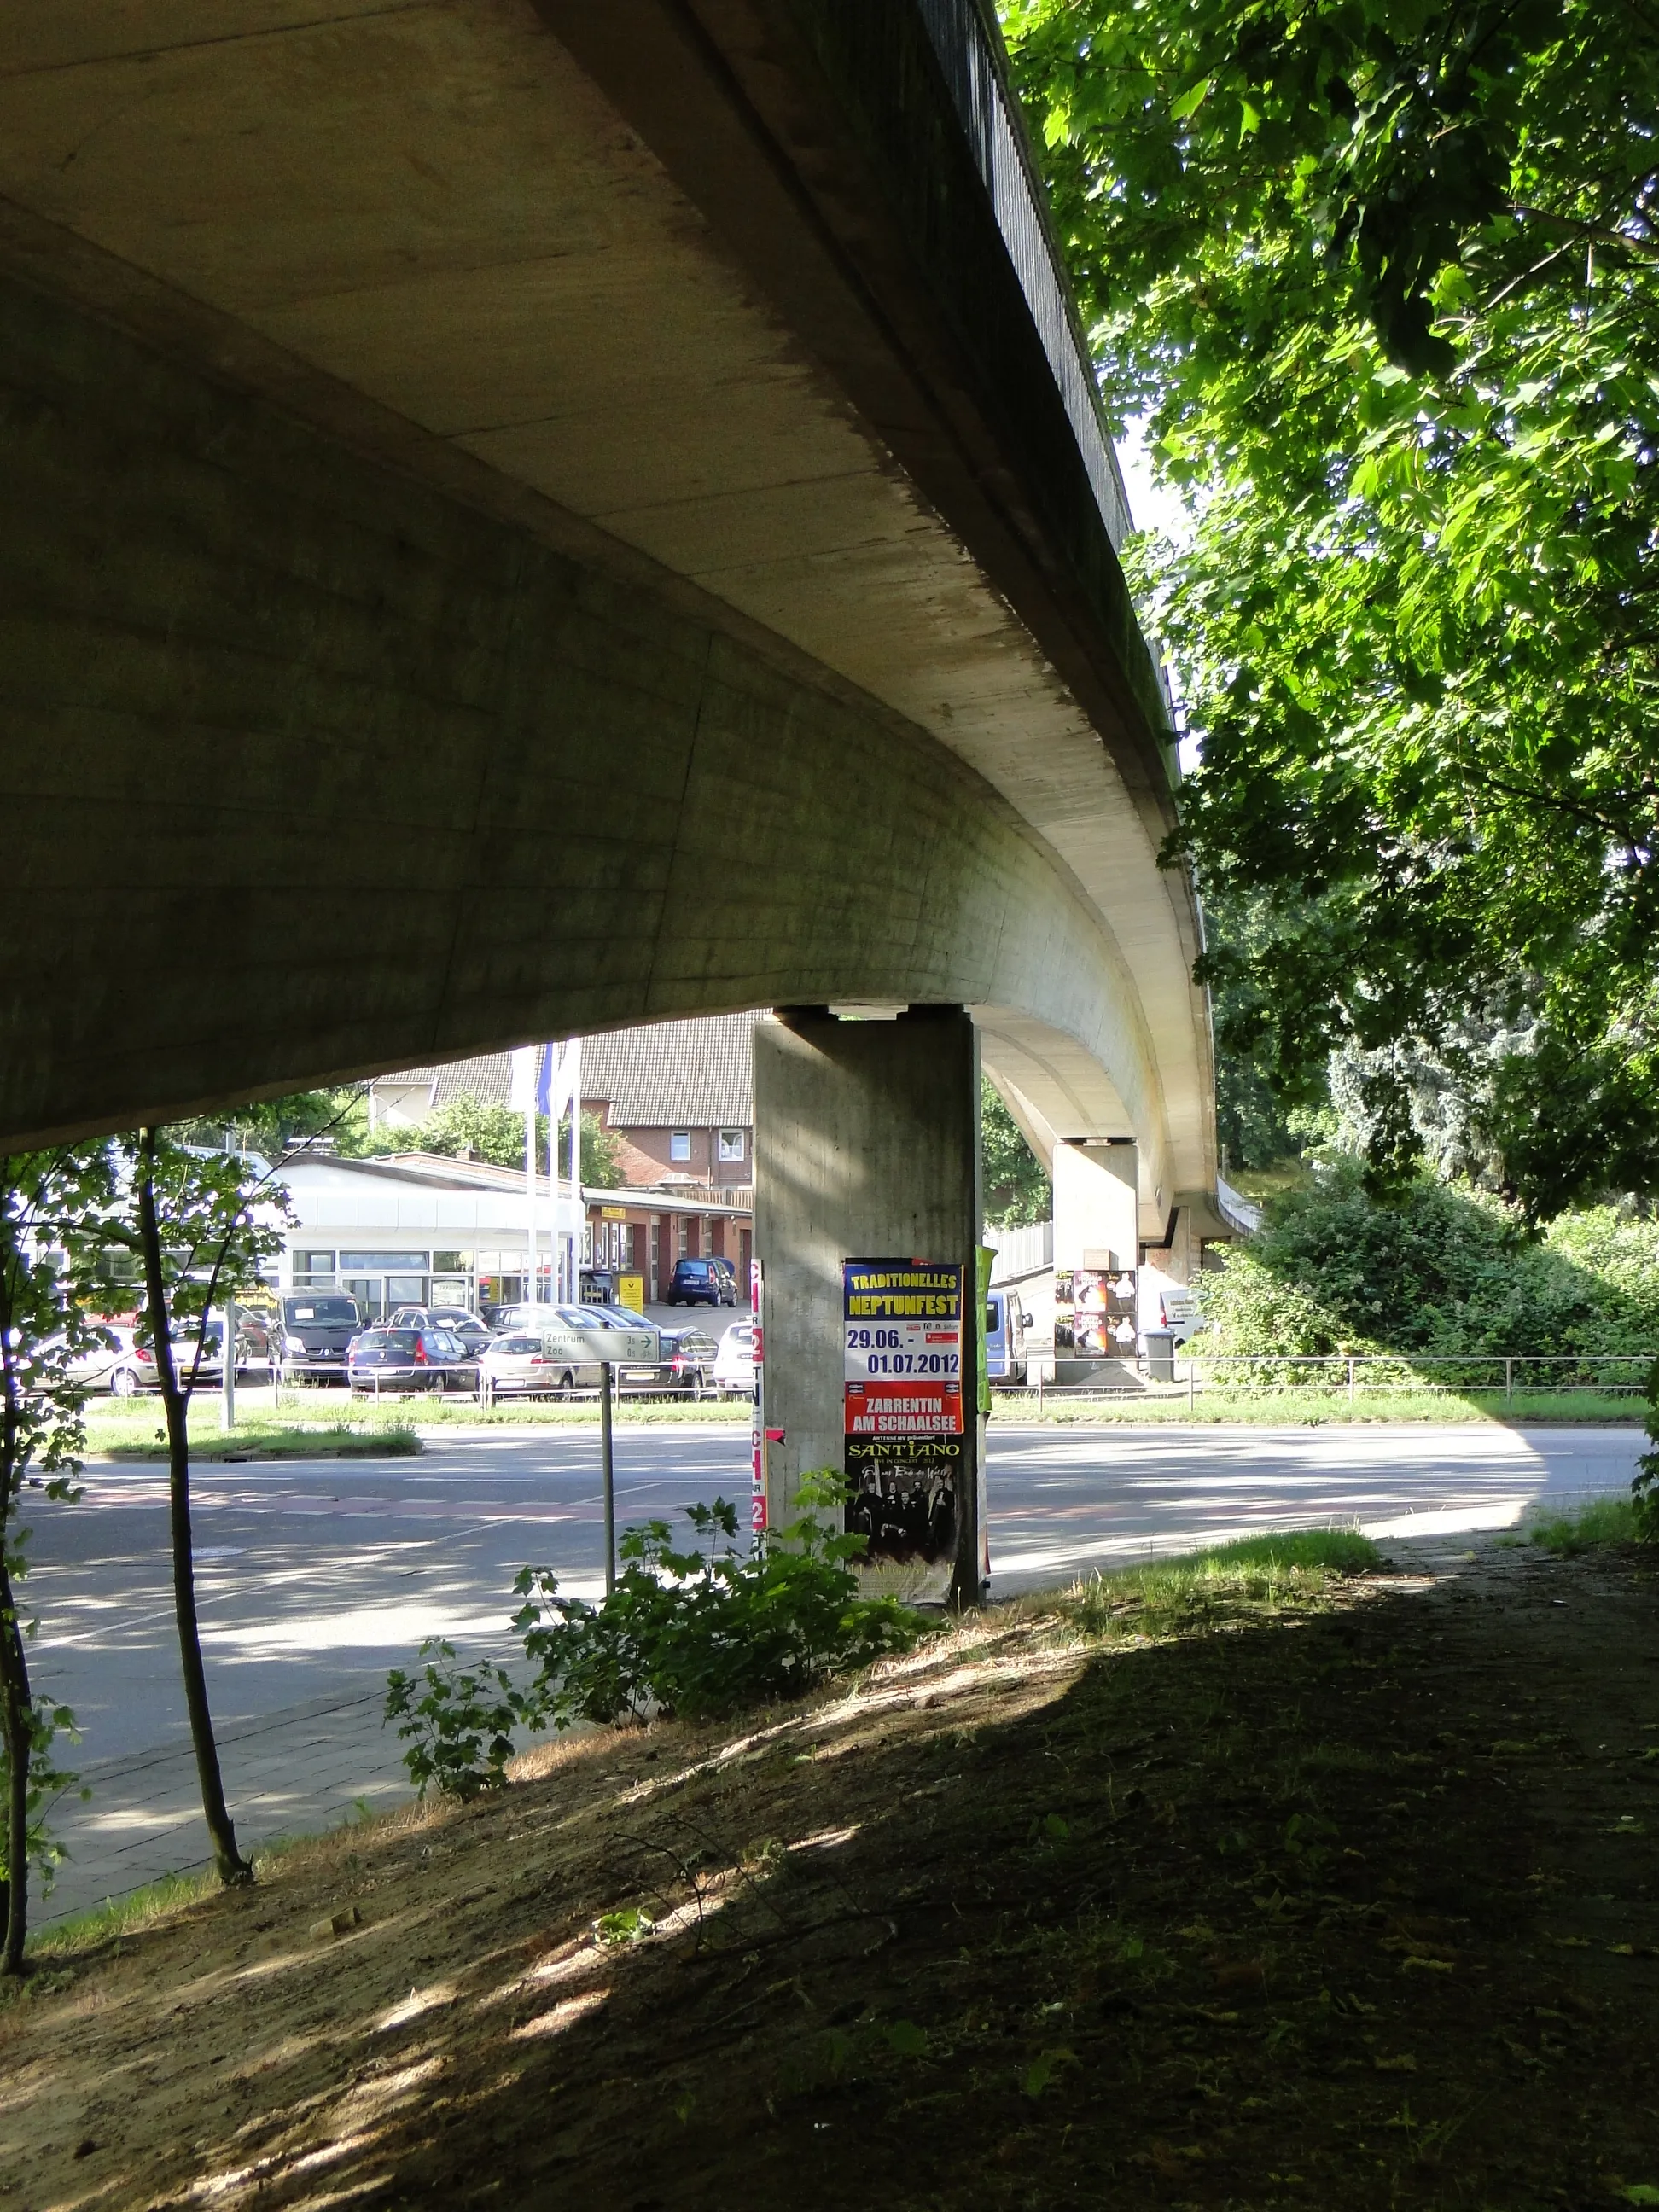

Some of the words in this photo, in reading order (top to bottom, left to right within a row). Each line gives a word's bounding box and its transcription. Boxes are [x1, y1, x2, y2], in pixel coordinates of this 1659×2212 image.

[851, 1272, 957, 1290] TRADITIONELLES
[849, 1295, 958, 1315] NEPTUNFEST
[547, 1334, 585, 1343] Zentrum
[847, 1330, 904, 1348] 29.06.
[547, 1347, 563, 1355] Zoo
[868, 1354, 958, 1373] 01.07.2012
[867, 1398, 942, 1413] ZARRENTIN
[853, 1416, 875, 1431] AM
[878, 1416, 956, 1431] SCHAALSEE
